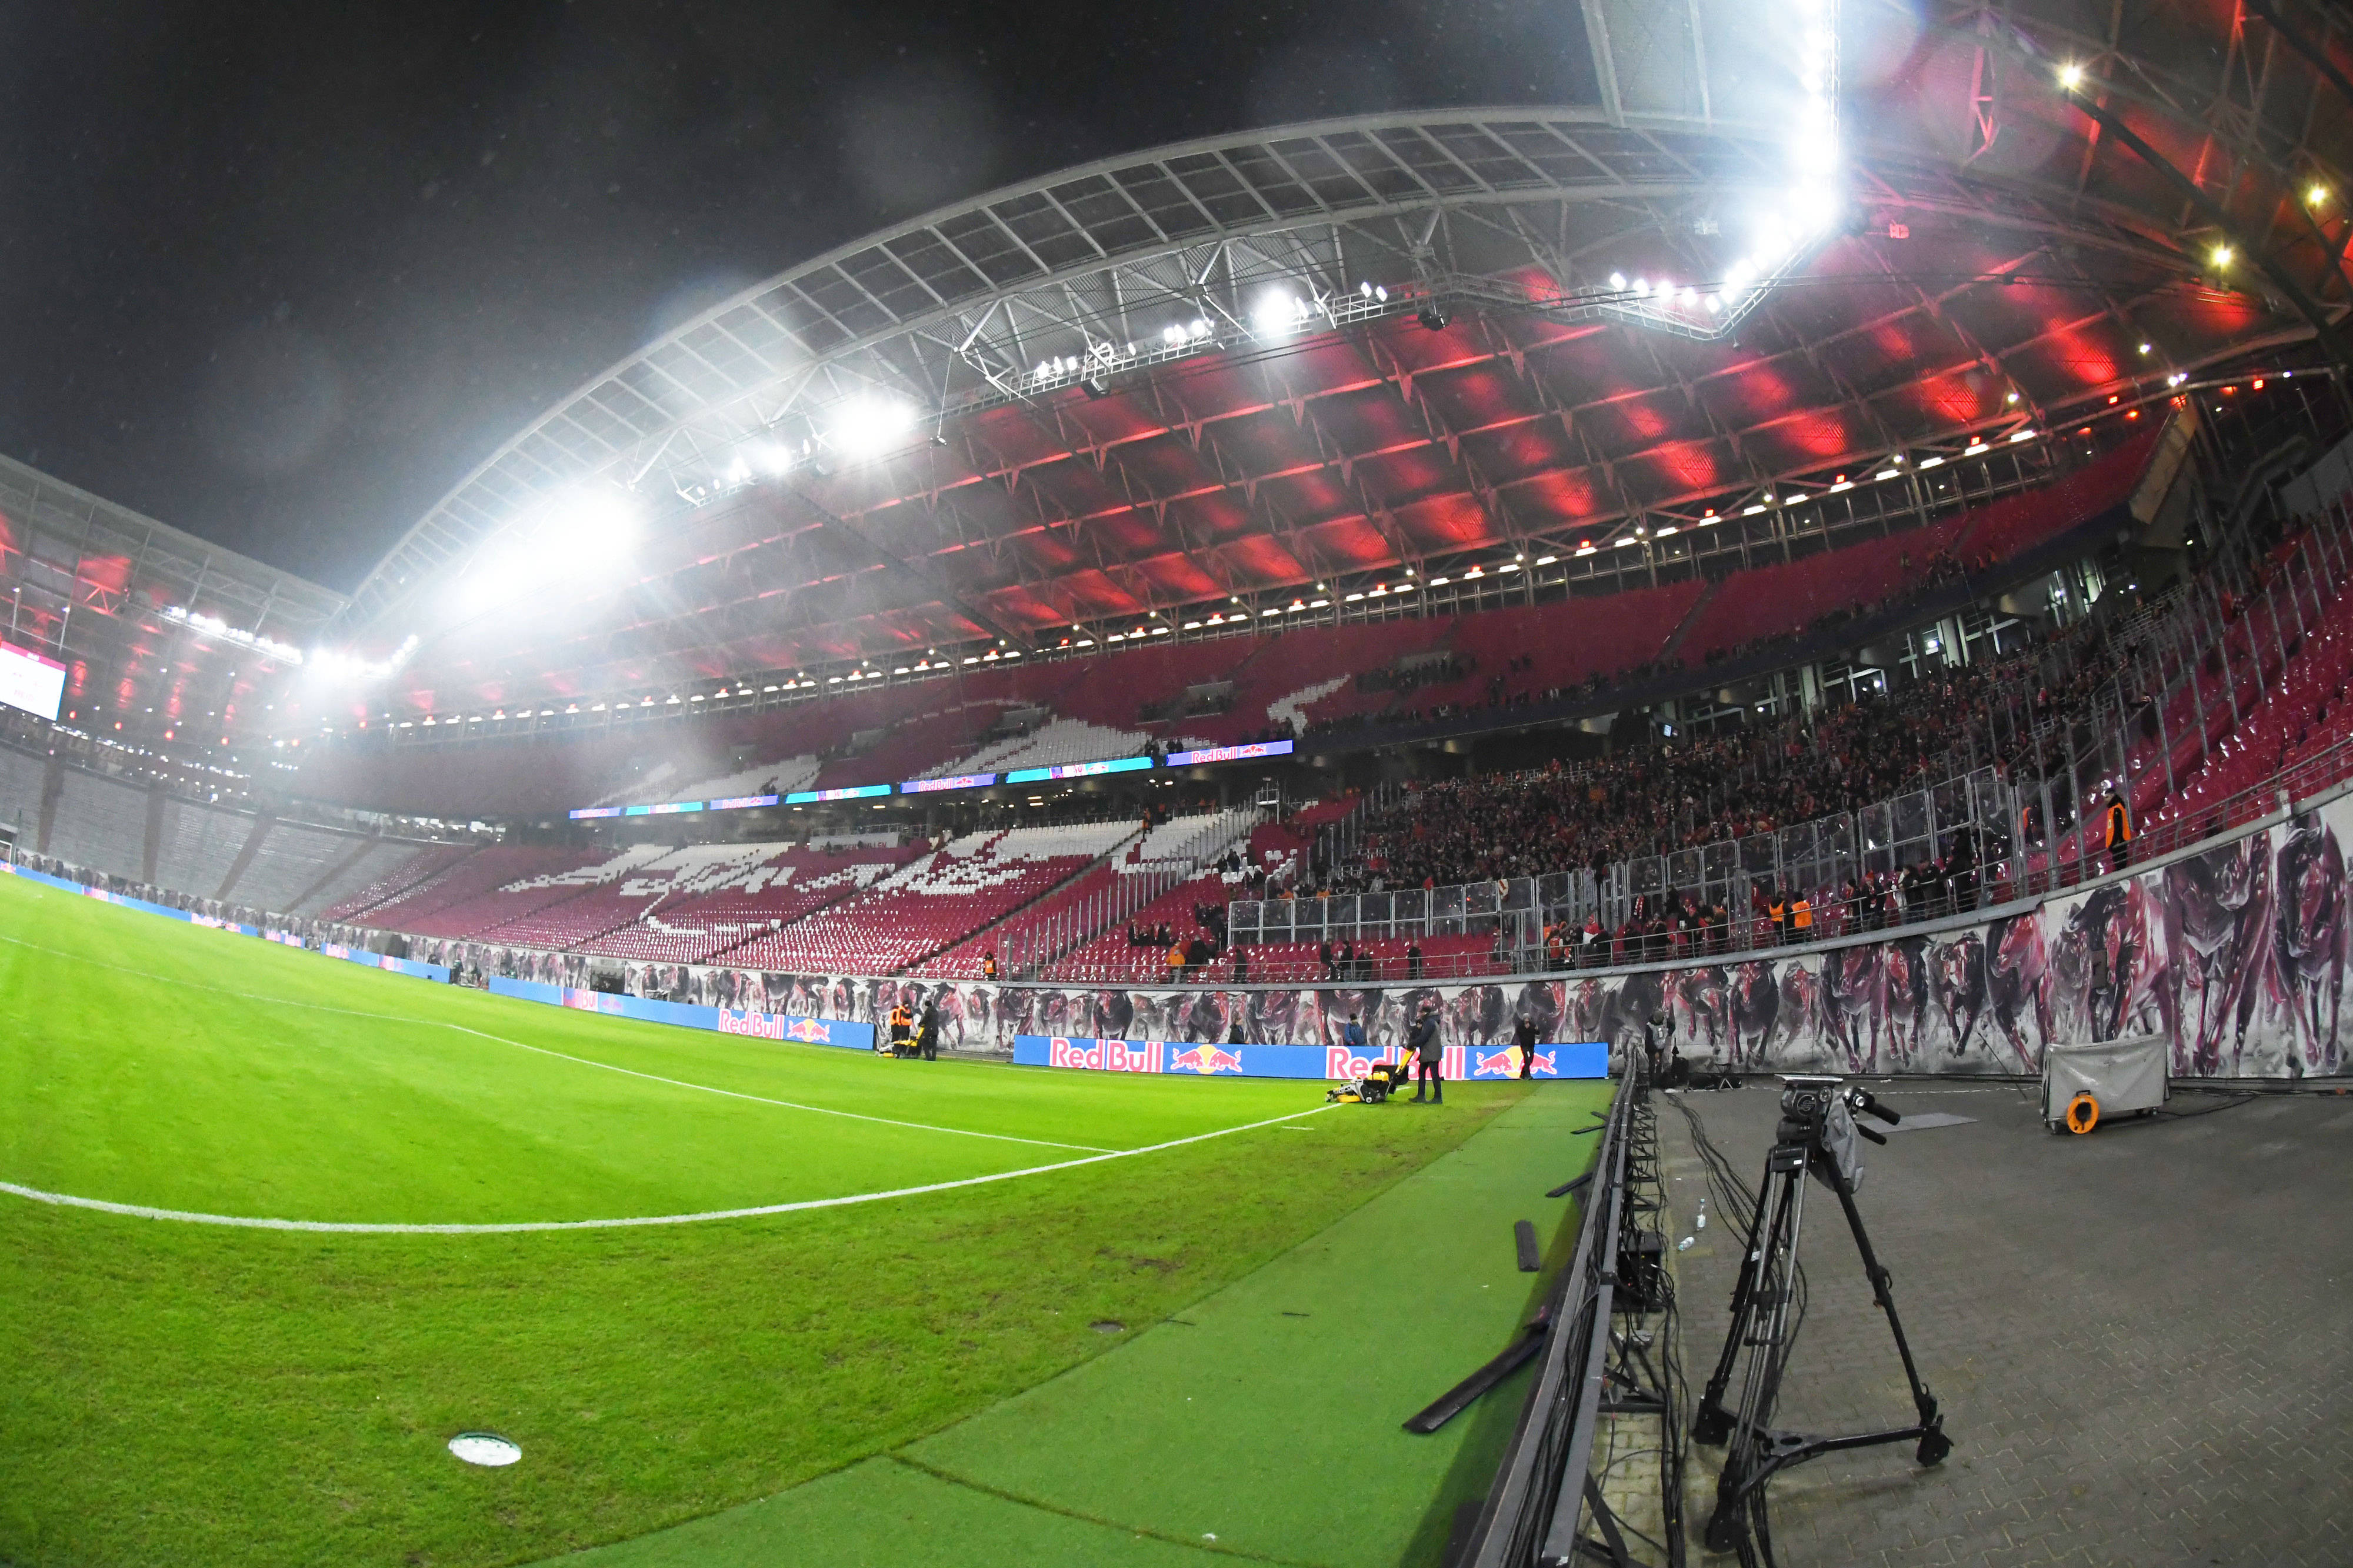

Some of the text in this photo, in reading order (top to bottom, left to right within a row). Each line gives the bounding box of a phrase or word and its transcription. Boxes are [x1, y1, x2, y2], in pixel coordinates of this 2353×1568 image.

[1192, 747, 1237, 764] Red Bull
[919, 778, 953, 792] Red Bull
[719, 1009, 784, 1040] Red Bull
[1051, 1038, 1162, 1073] Red Bull
